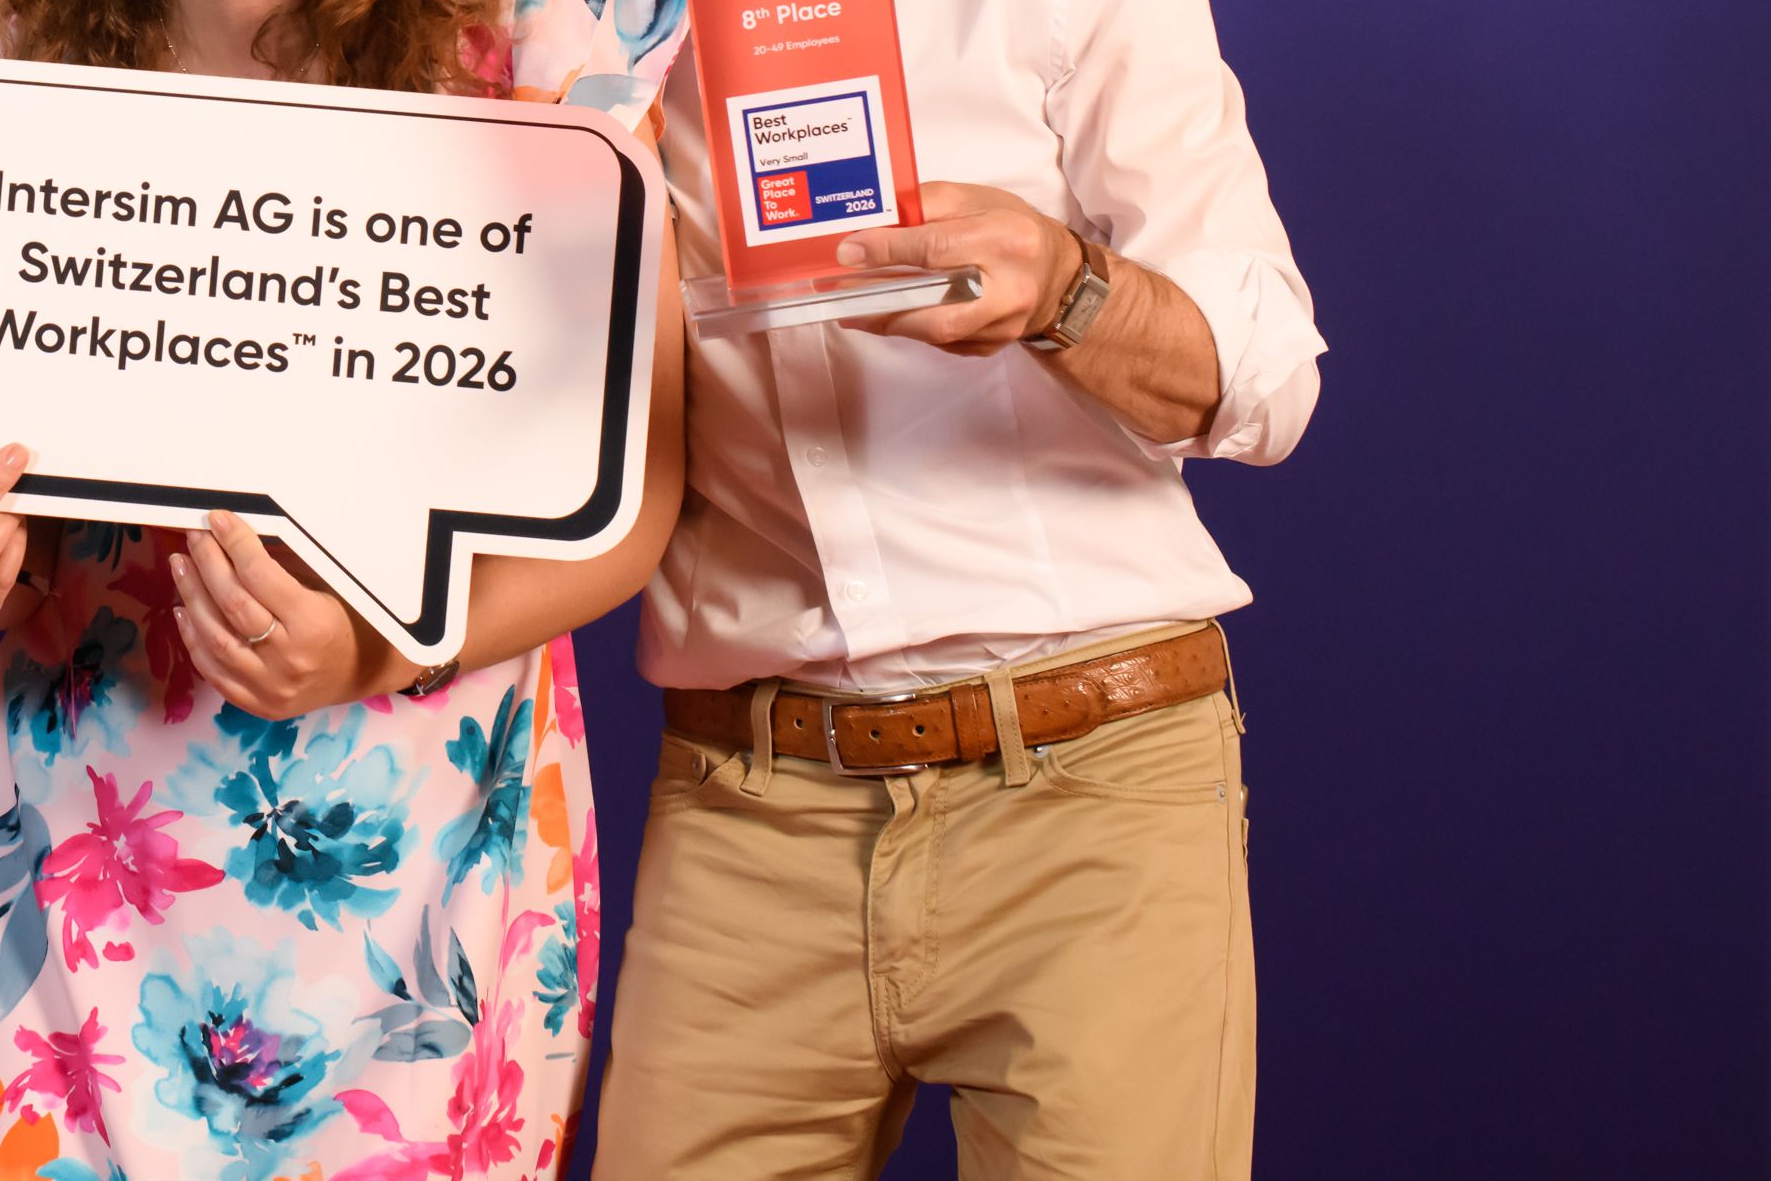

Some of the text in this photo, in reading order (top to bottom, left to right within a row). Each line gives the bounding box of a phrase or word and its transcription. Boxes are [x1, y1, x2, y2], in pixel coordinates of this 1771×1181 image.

[742, 1, 842, 30] 8th Place
[786, 35, 841, 51] Employees
[753, 115, 787, 130] Best
[760, 152, 808, 167] Very Small
[761, 177, 795, 190] Great
[763, 188, 796, 200] Place
[815, 188, 874, 204] SWITZERLAND
[764, 200, 777, 210] To
[846, 199, 876, 213] 2026
[213, 190, 294, 234] AG
[311, 196, 348, 240] is
[365, 212, 463, 249] one
[479, 213, 533, 254] of
[18, 241, 491, 321] Switzerland’s Best
[332, 336, 375, 380] in
[391, 341, 518, 392] 2026
